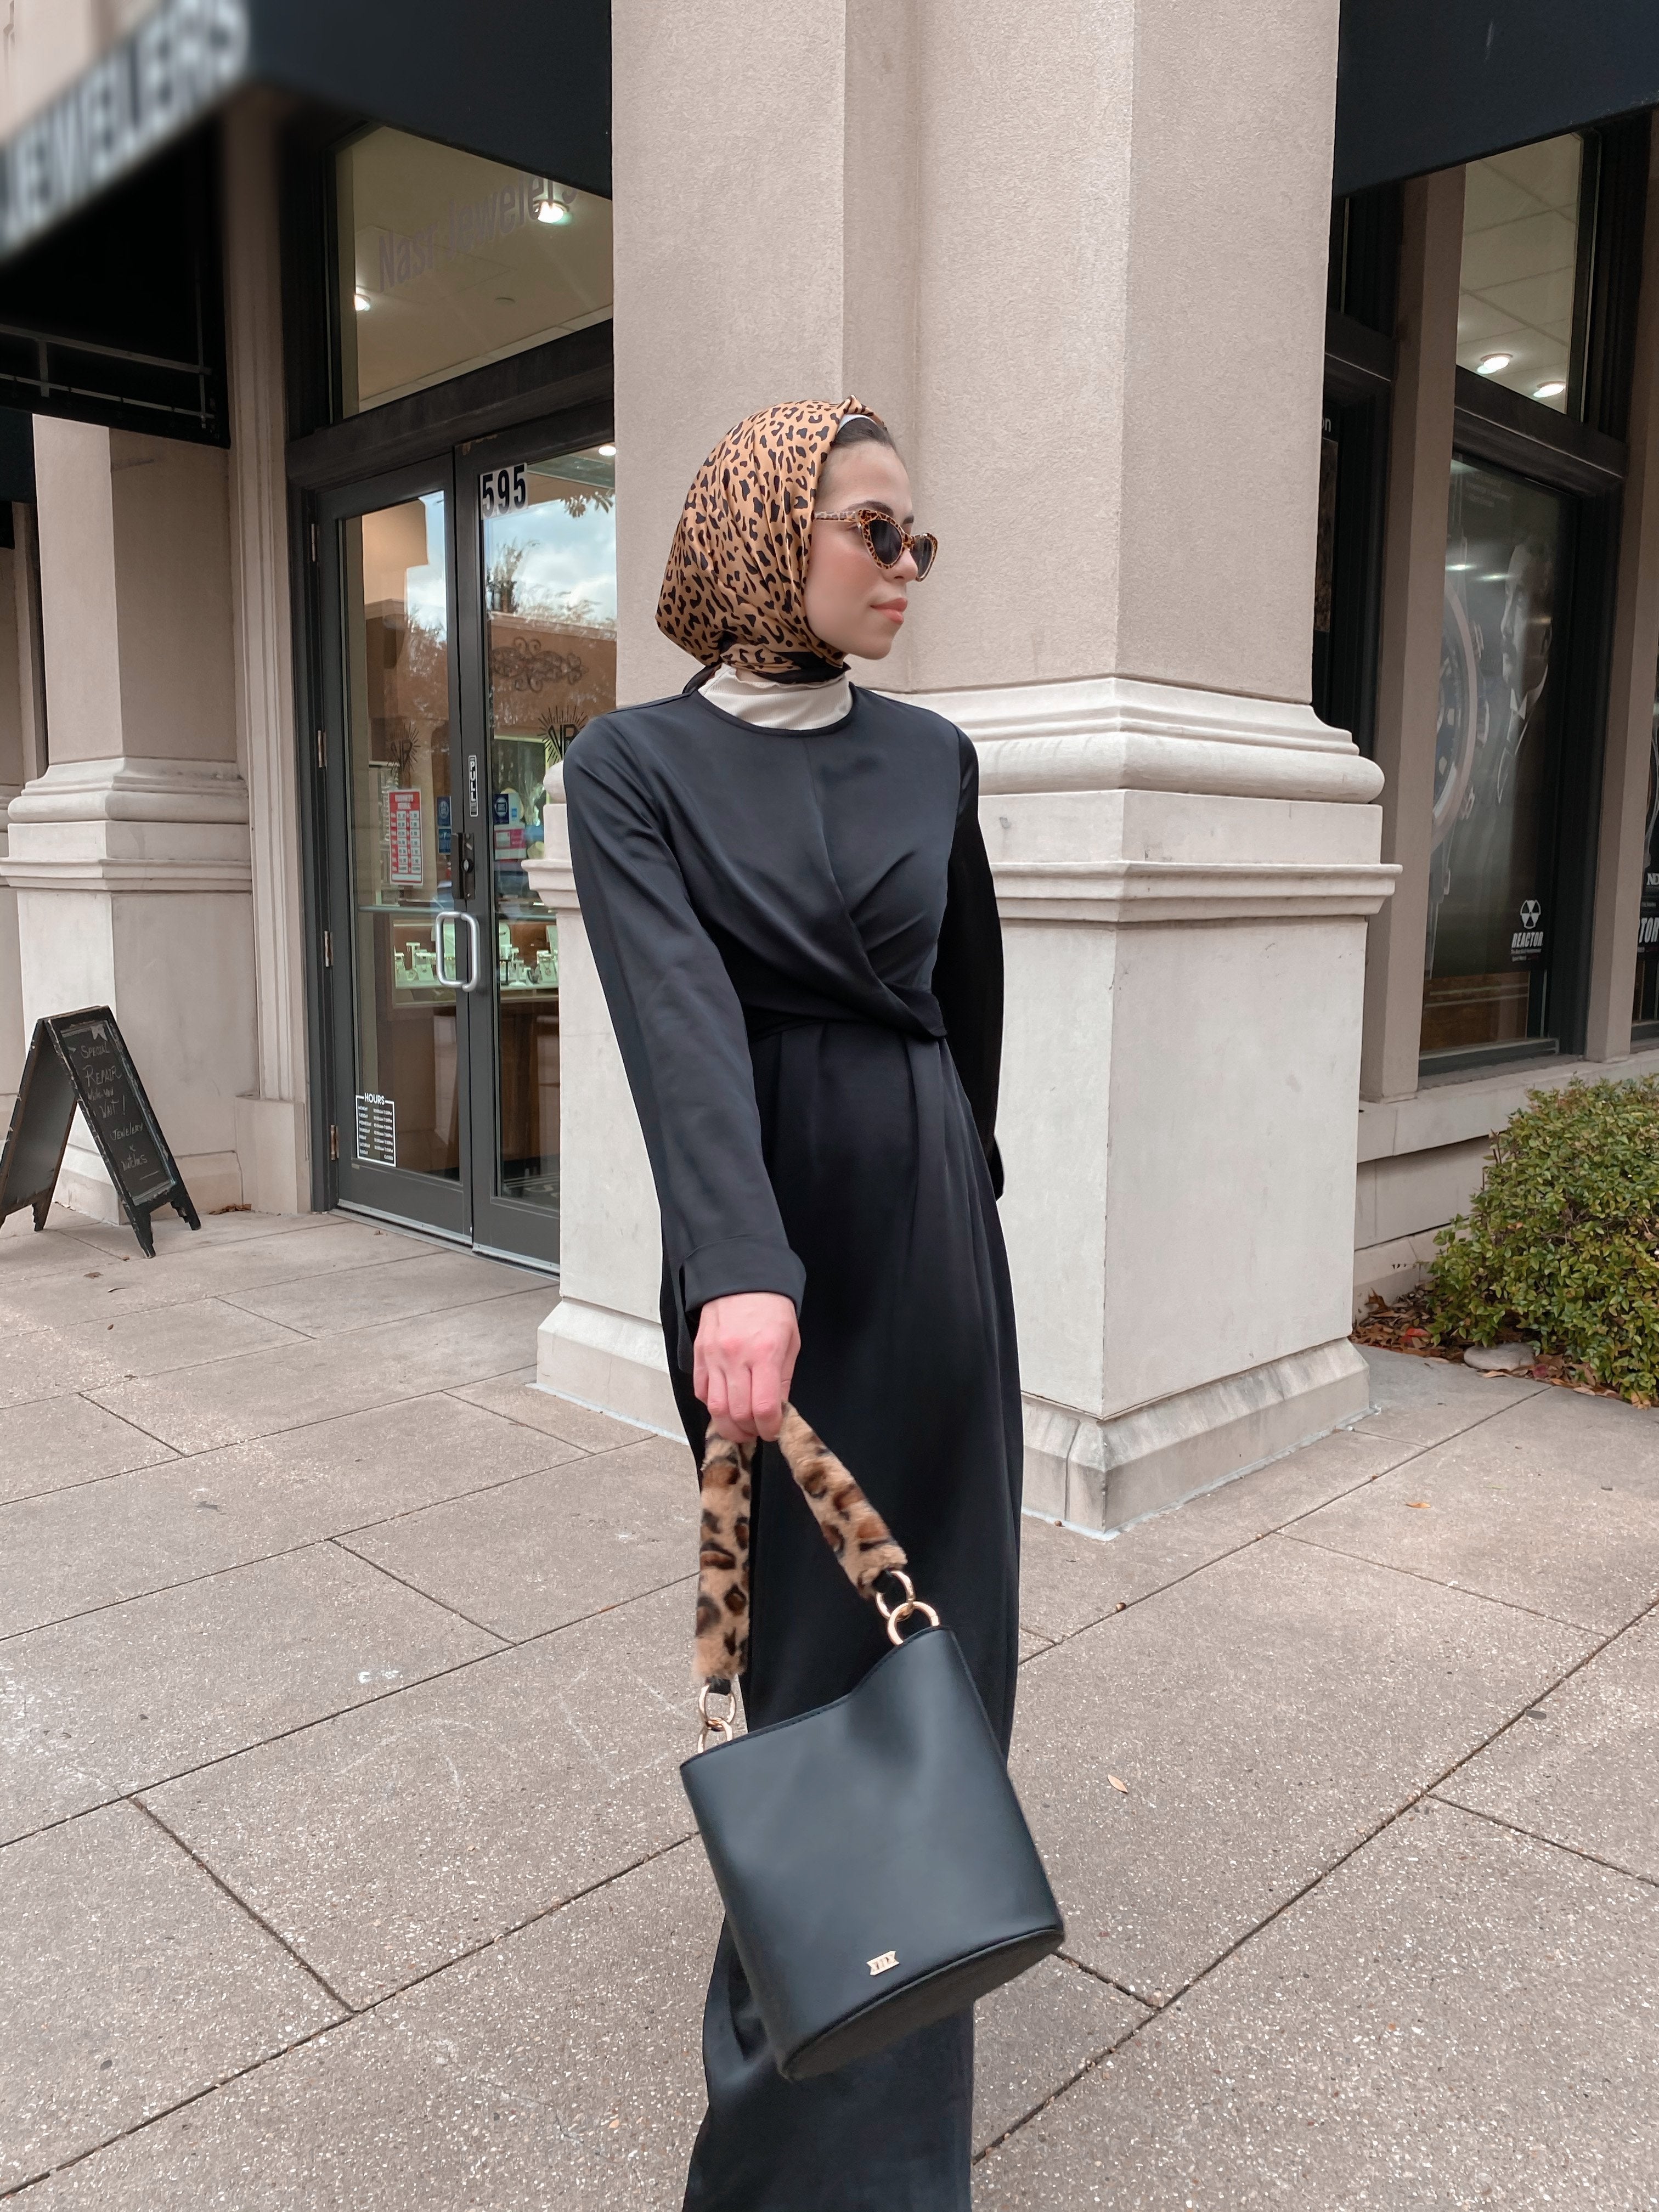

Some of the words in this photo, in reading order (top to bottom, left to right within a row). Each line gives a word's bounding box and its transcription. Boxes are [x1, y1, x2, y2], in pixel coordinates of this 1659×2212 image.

[379, 221, 438, 294] Nasr
[483, 464, 526, 517] 595
[1511, 932, 1543, 948] REACTOR
[1639, 917, 1659, 943] TOR
[364, 1092, 385, 1105] HOURS
